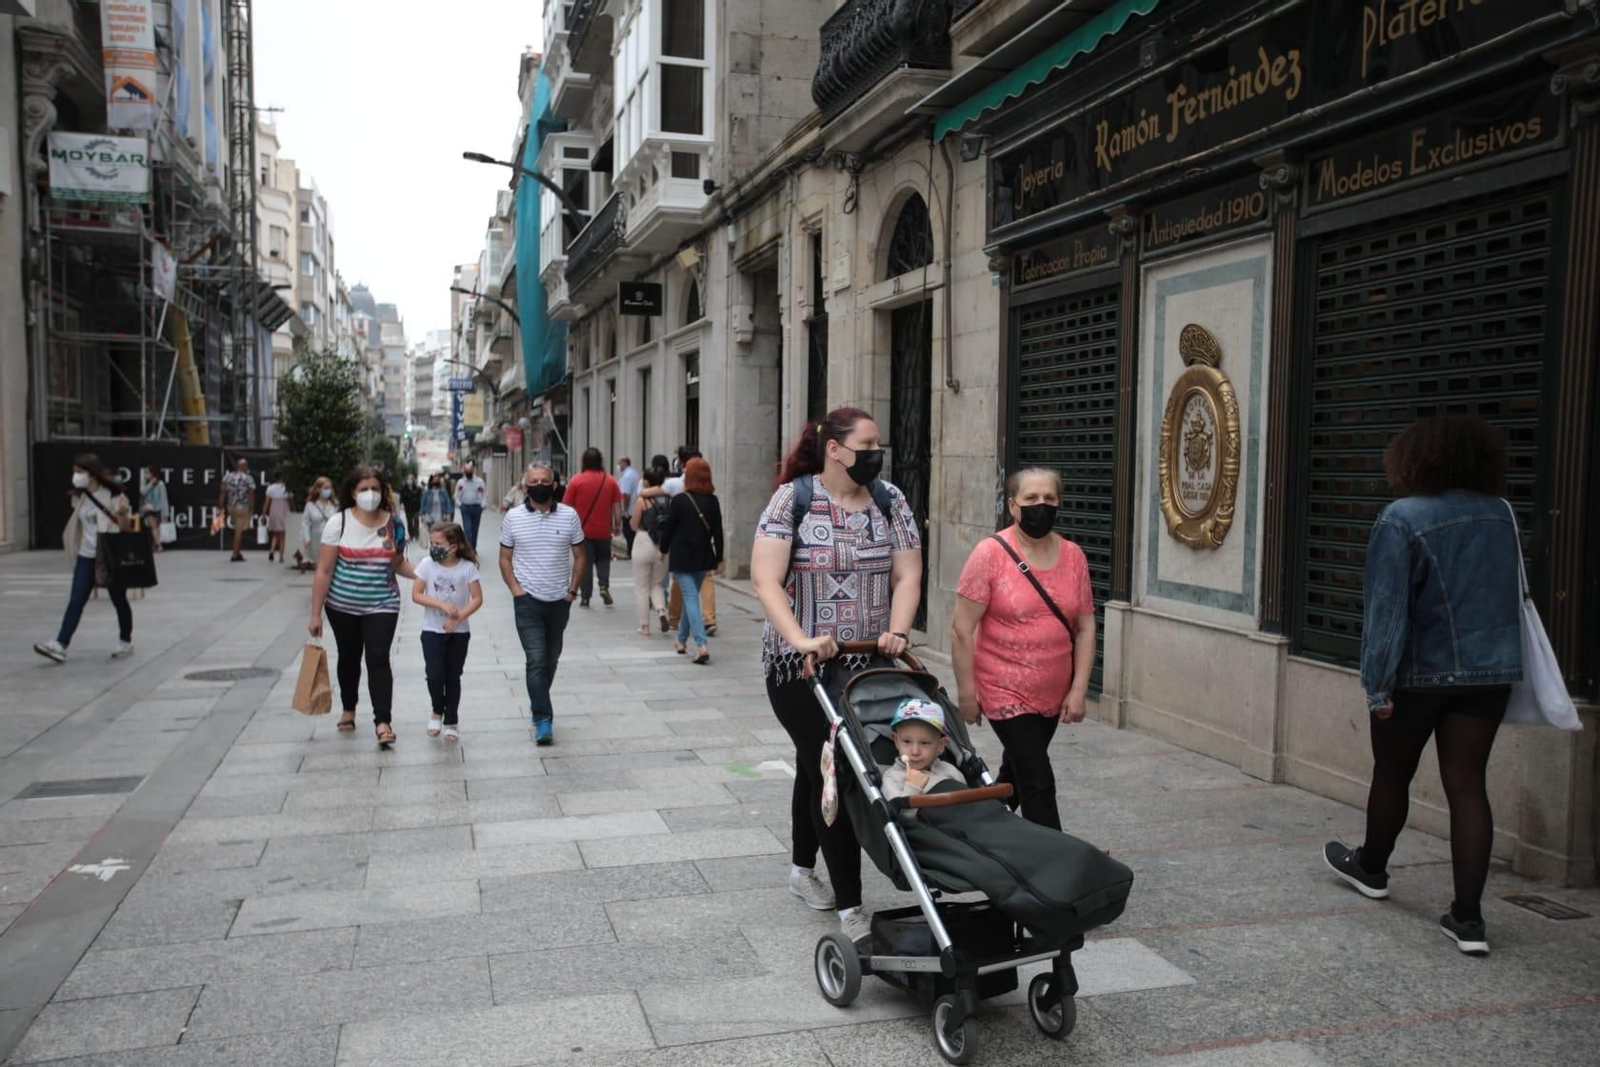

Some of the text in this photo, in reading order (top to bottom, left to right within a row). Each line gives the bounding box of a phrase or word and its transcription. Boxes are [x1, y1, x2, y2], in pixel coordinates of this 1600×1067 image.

[1095, 46, 1302, 172] Ramón Fernández
[51, 149, 148, 168] MOYBAR
[1317, 116, 1542, 202] Modelos Exclusivos
[1226, 191, 1264, 225] 1910
[1074, 240, 1107, 268] Propia
